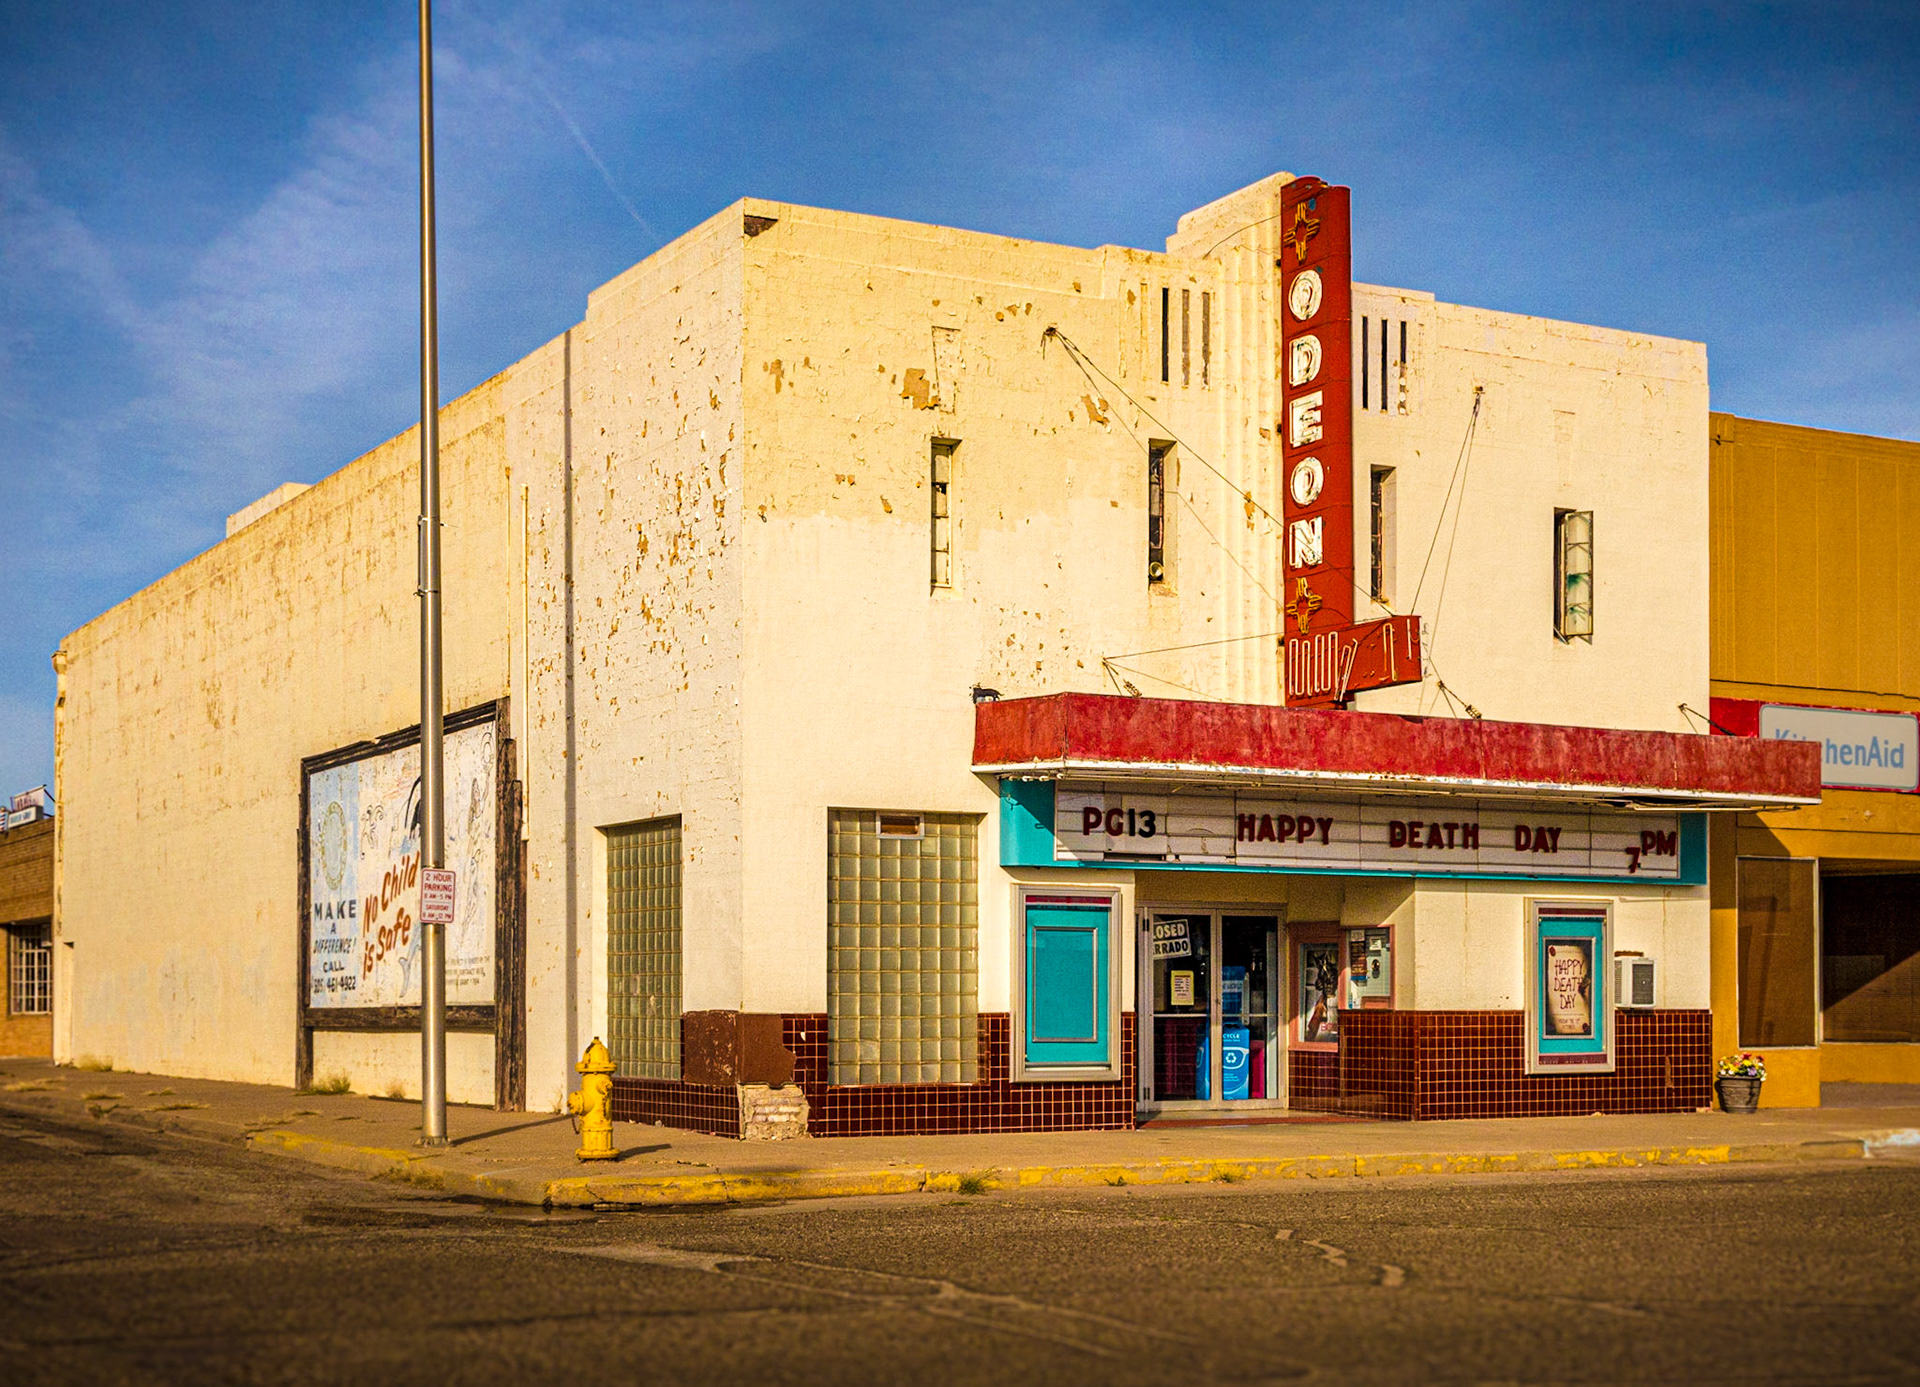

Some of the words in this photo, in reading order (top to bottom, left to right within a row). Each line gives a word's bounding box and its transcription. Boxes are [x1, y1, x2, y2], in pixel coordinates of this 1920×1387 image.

[1288, 268, 1325, 567] ODEON
[1775, 728, 1905, 769] henAid
[1082, 806, 1157, 838] PG13
[1237, 813, 1334, 845] HAPPY
[1389, 820, 1480, 850] DEATH
[1515, 825, 1562, 853] DAY
[425, 873, 431, 881] 2
[433, 873, 452, 882] HOUR
[362, 894, 378, 938] No
[381, 851, 419, 912] Child
[424, 883, 453, 892] PARKING
[314, 899, 357, 921] MAKE
[329, 922, 337, 935] A
[1154, 922, 1186, 939] OSED
[363, 941, 375, 981] is
[376, 907, 411, 962] Safe
[1153, 940, 1189, 956] RRADO
[322, 961, 345, 973] CALL
[1554, 958, 1585, 976] HAPPY
[1560, 994, 1577, 1010] DAY
